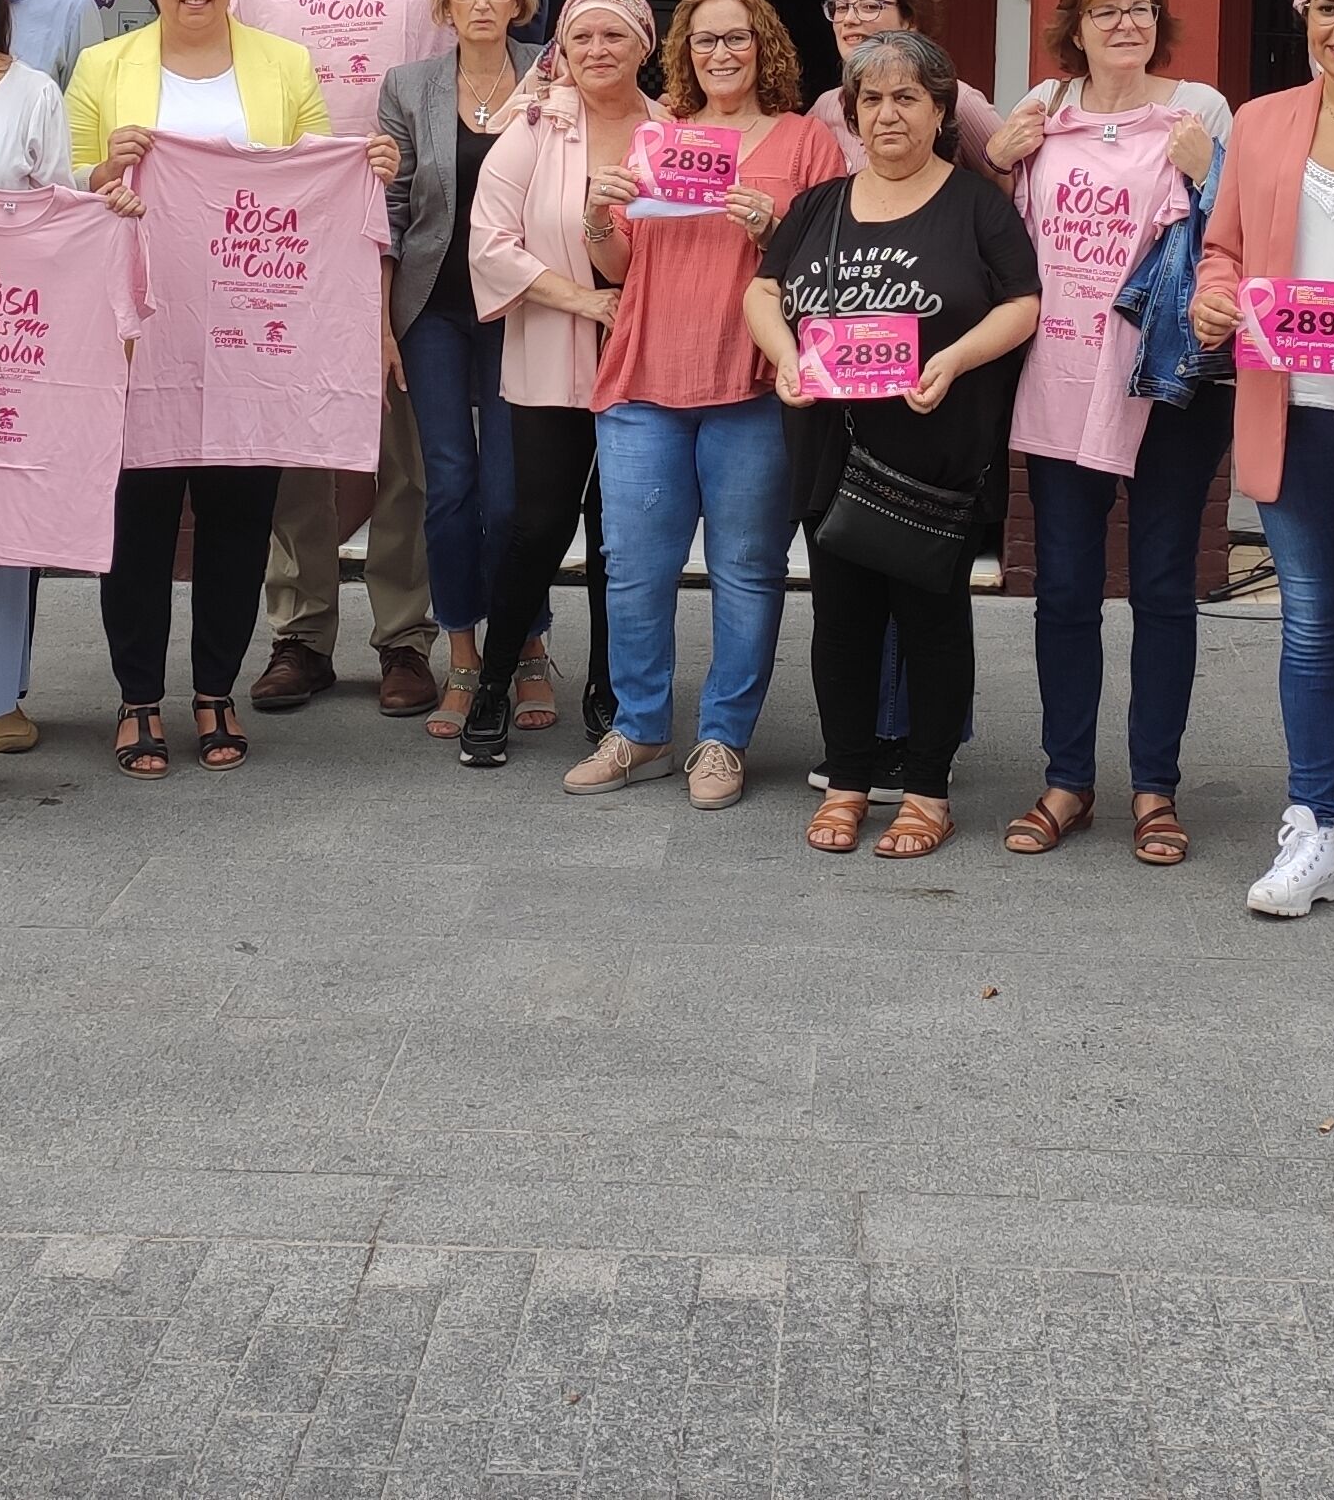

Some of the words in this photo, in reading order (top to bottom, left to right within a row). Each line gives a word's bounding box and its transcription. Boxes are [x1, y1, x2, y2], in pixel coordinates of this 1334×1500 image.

[309, 1, 326, 16] un
[659, 147, 732, 175] 2895
[1056, 182, 1130, 216] ROSA
[224, 206, 298, 235] ROSA
[1042, 215, 1060, 237] es
[1063, 212, 1104, 237] más
[1107, 218, 1138, 240] que
[210, 236, 228, 256] es
[231, 231, 272, 253] más
[275, 235, 309, 254] que
[1055, 235, 1071, 252] un
[223, 253, 240, 268] un
[860, 264, 883, 279] 93
[14, 318, 50, 338] que
[835, 341, 912, 366] 2898
